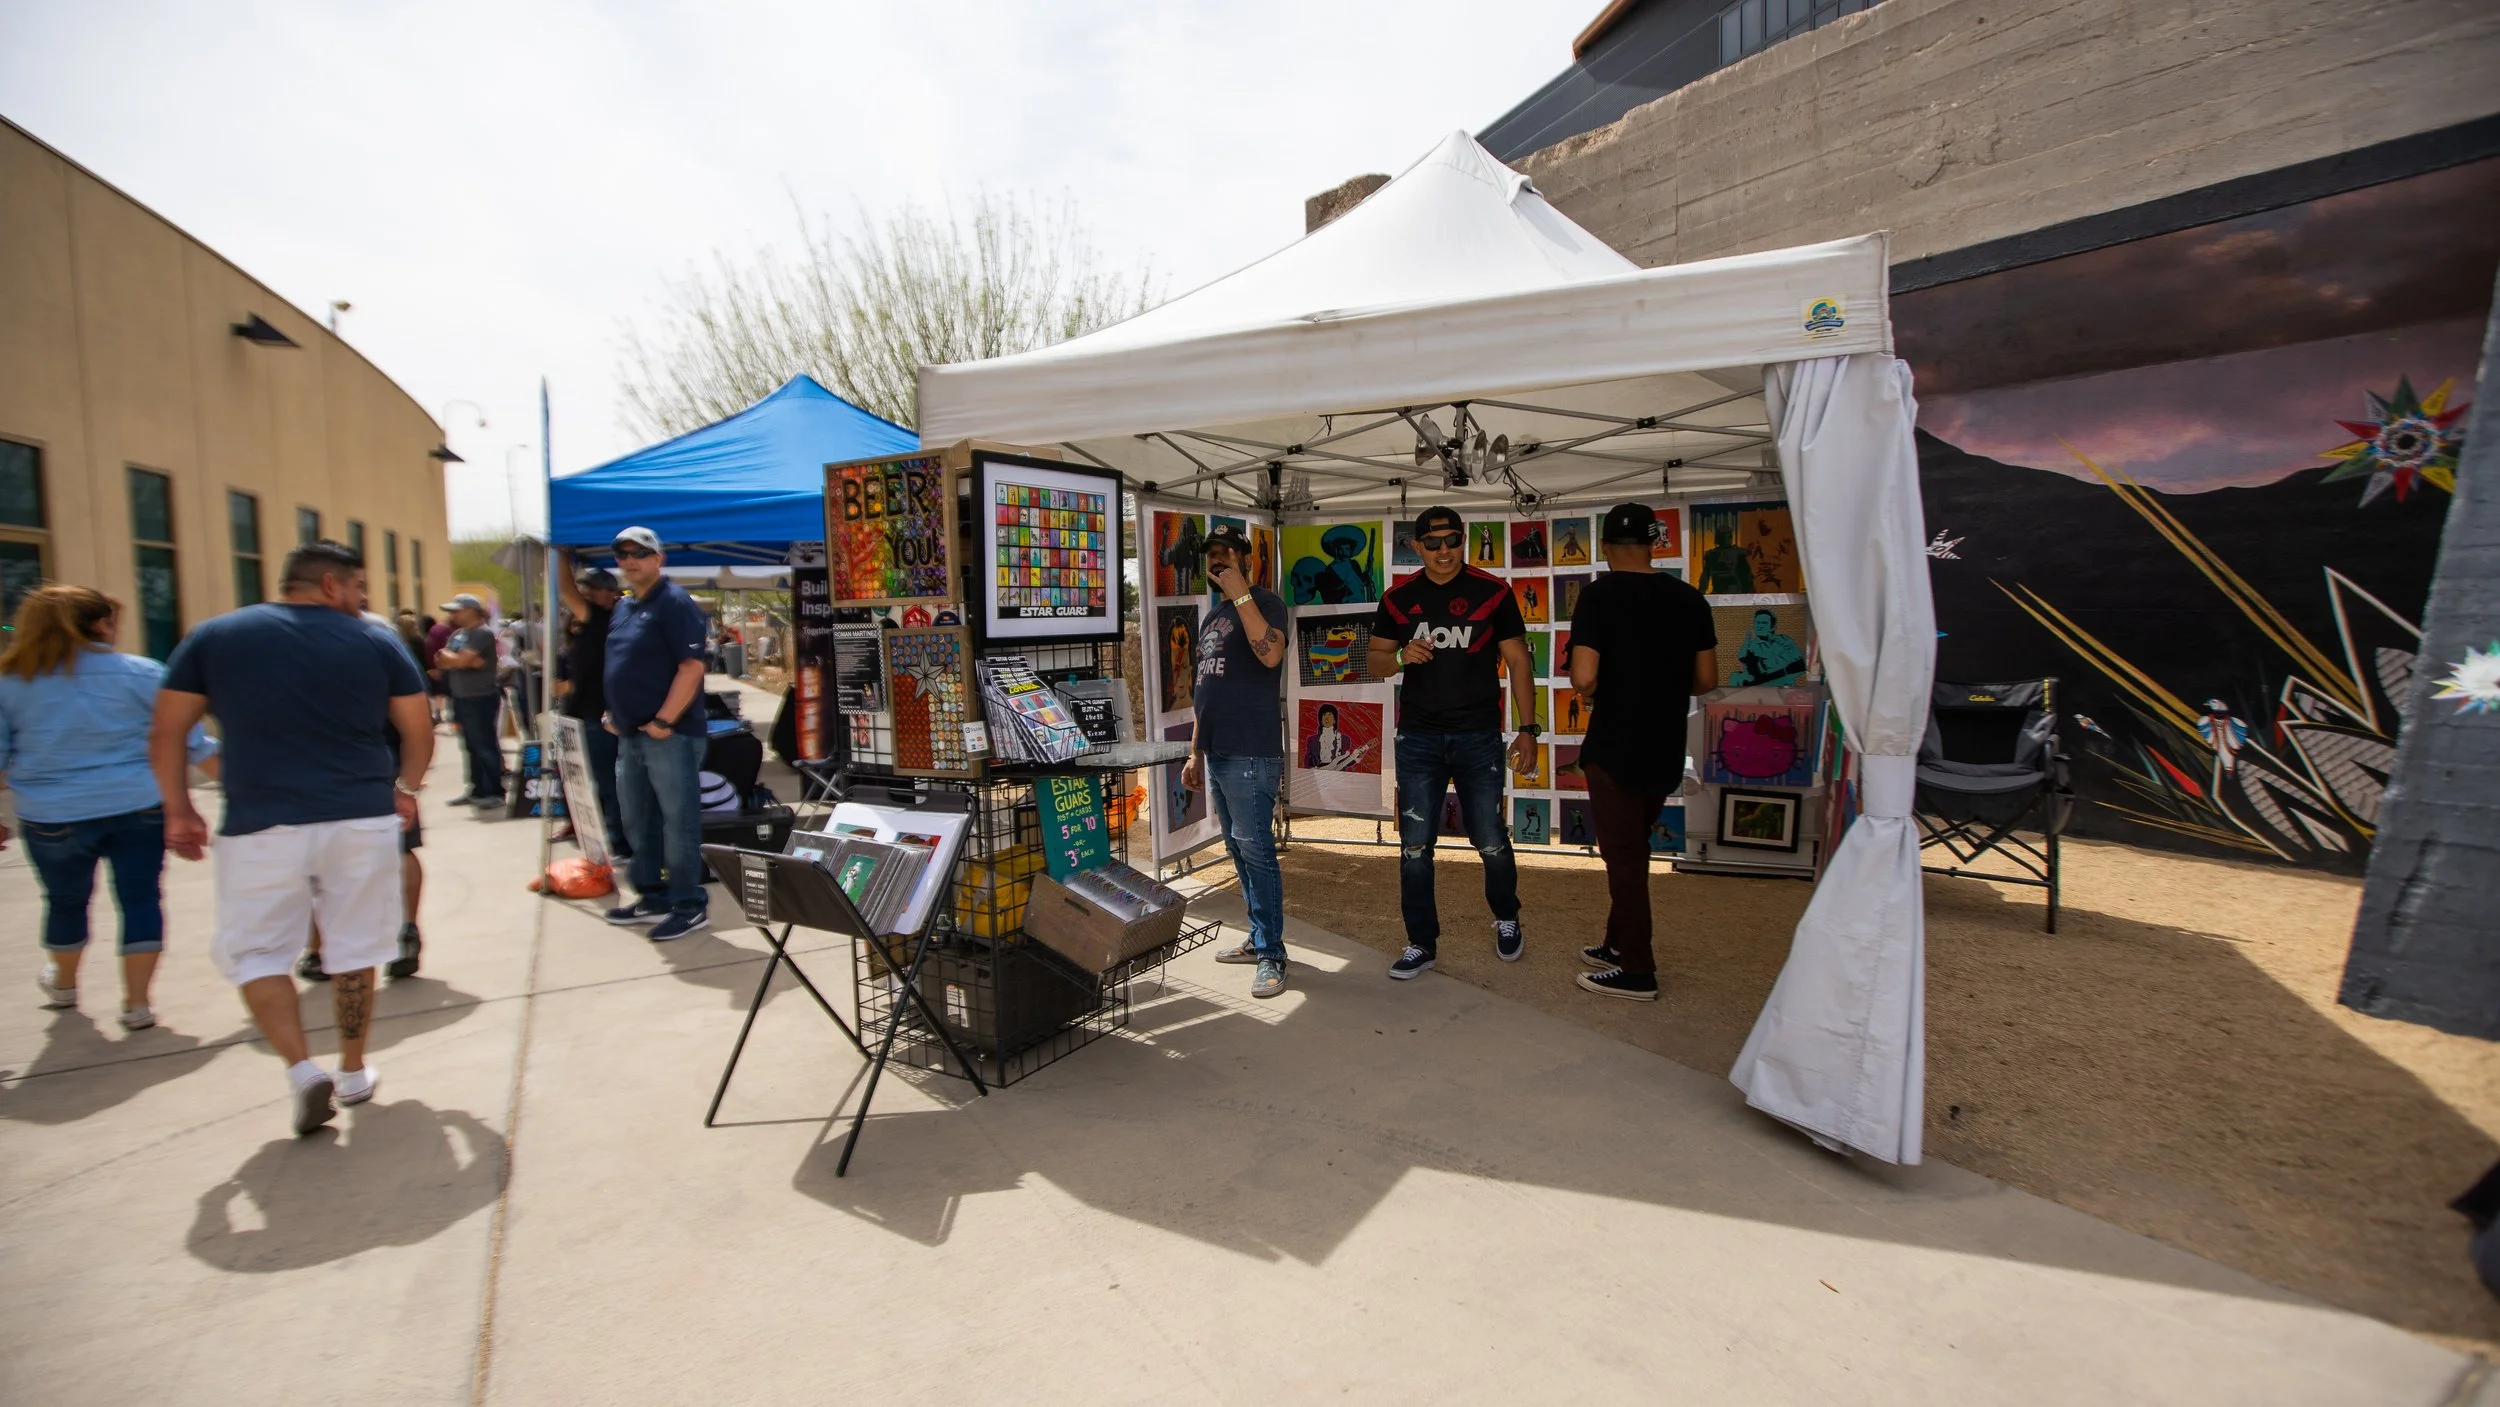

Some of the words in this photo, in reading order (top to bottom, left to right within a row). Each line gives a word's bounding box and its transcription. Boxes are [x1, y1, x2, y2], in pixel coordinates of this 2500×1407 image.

[844, 471, 931, 520] BEER
[884, 528, 938, 570] YOU!
[801, 580, 829, 596] Buil
[1020, 606, 1053, 617] ESTAR
[1056, 606, 1088, 616] GUARS
[1409, 621, 1473, 649] AON
[1198, 657, 1226, 675] PIRE
[1051, 776, 1089, 796] ESTAR
[1055, 789, 1092, 812] GUARS
[1057, 812, 1069, 822] POST
[1075, 806, 1092, 816] CARDS
[1061, 824, 1070, 839] 5
[1071, 824, 1082, 834] FOR
[1081, 848, 1095, 858] EACH
